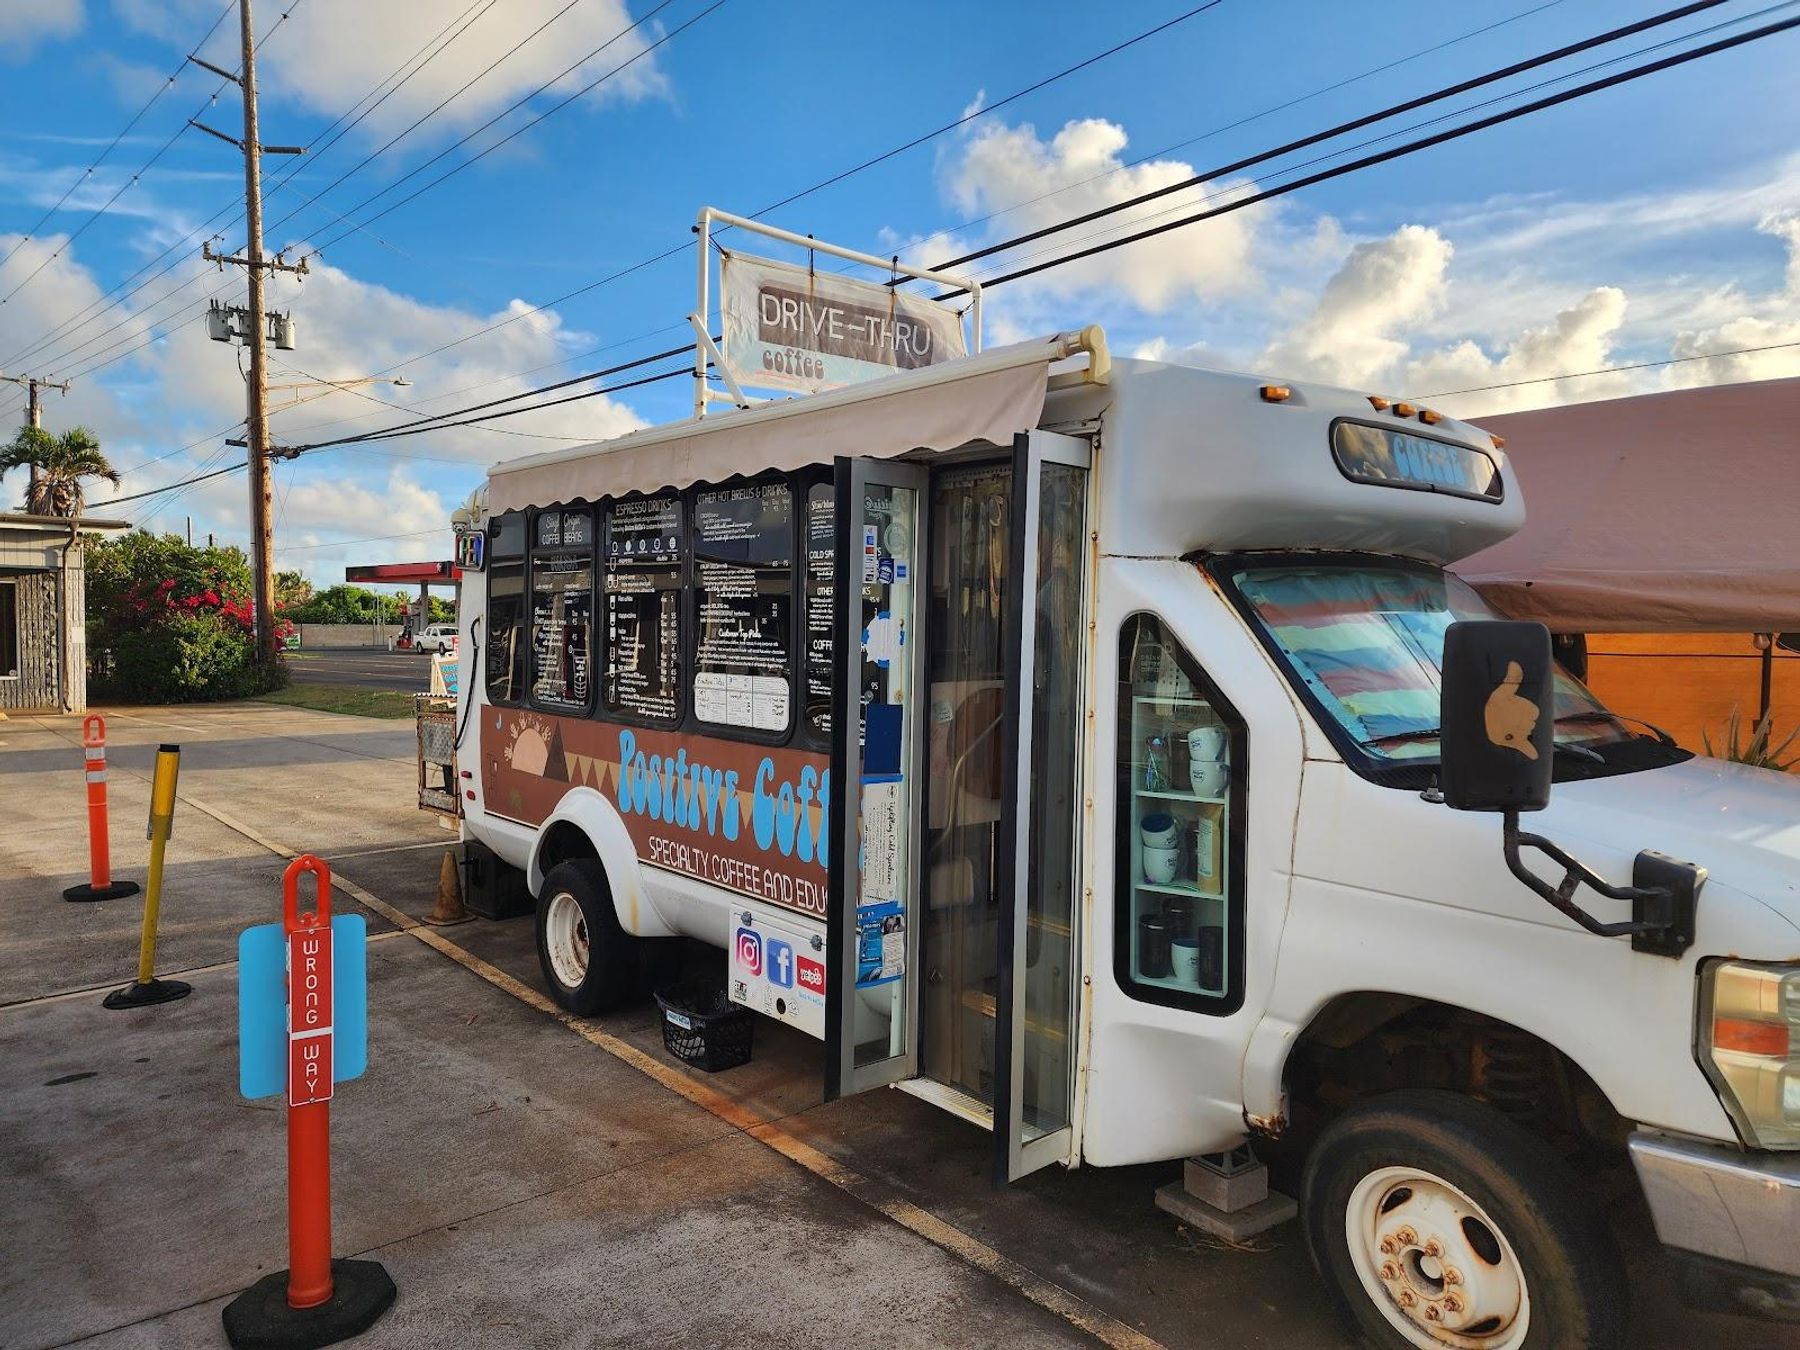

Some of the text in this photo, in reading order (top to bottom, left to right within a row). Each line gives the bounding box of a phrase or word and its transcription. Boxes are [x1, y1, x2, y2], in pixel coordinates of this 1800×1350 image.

[761, 293, 931, 356] DRIVE-THRU
[762, 347, 825, 380] coffee
[616, 501, 647, 516] ESPRESSO
[718, 490, 730, 502] HOT
[809, 551, 825, 560] COLD
[618, 729, 739, 842] Positive
[649, 836, 828, 914] SPECIALTY COFFEE AND EDU
[303, 939, 319, 1024] WRONG
[303, 1044, 320, 1093] WAY
